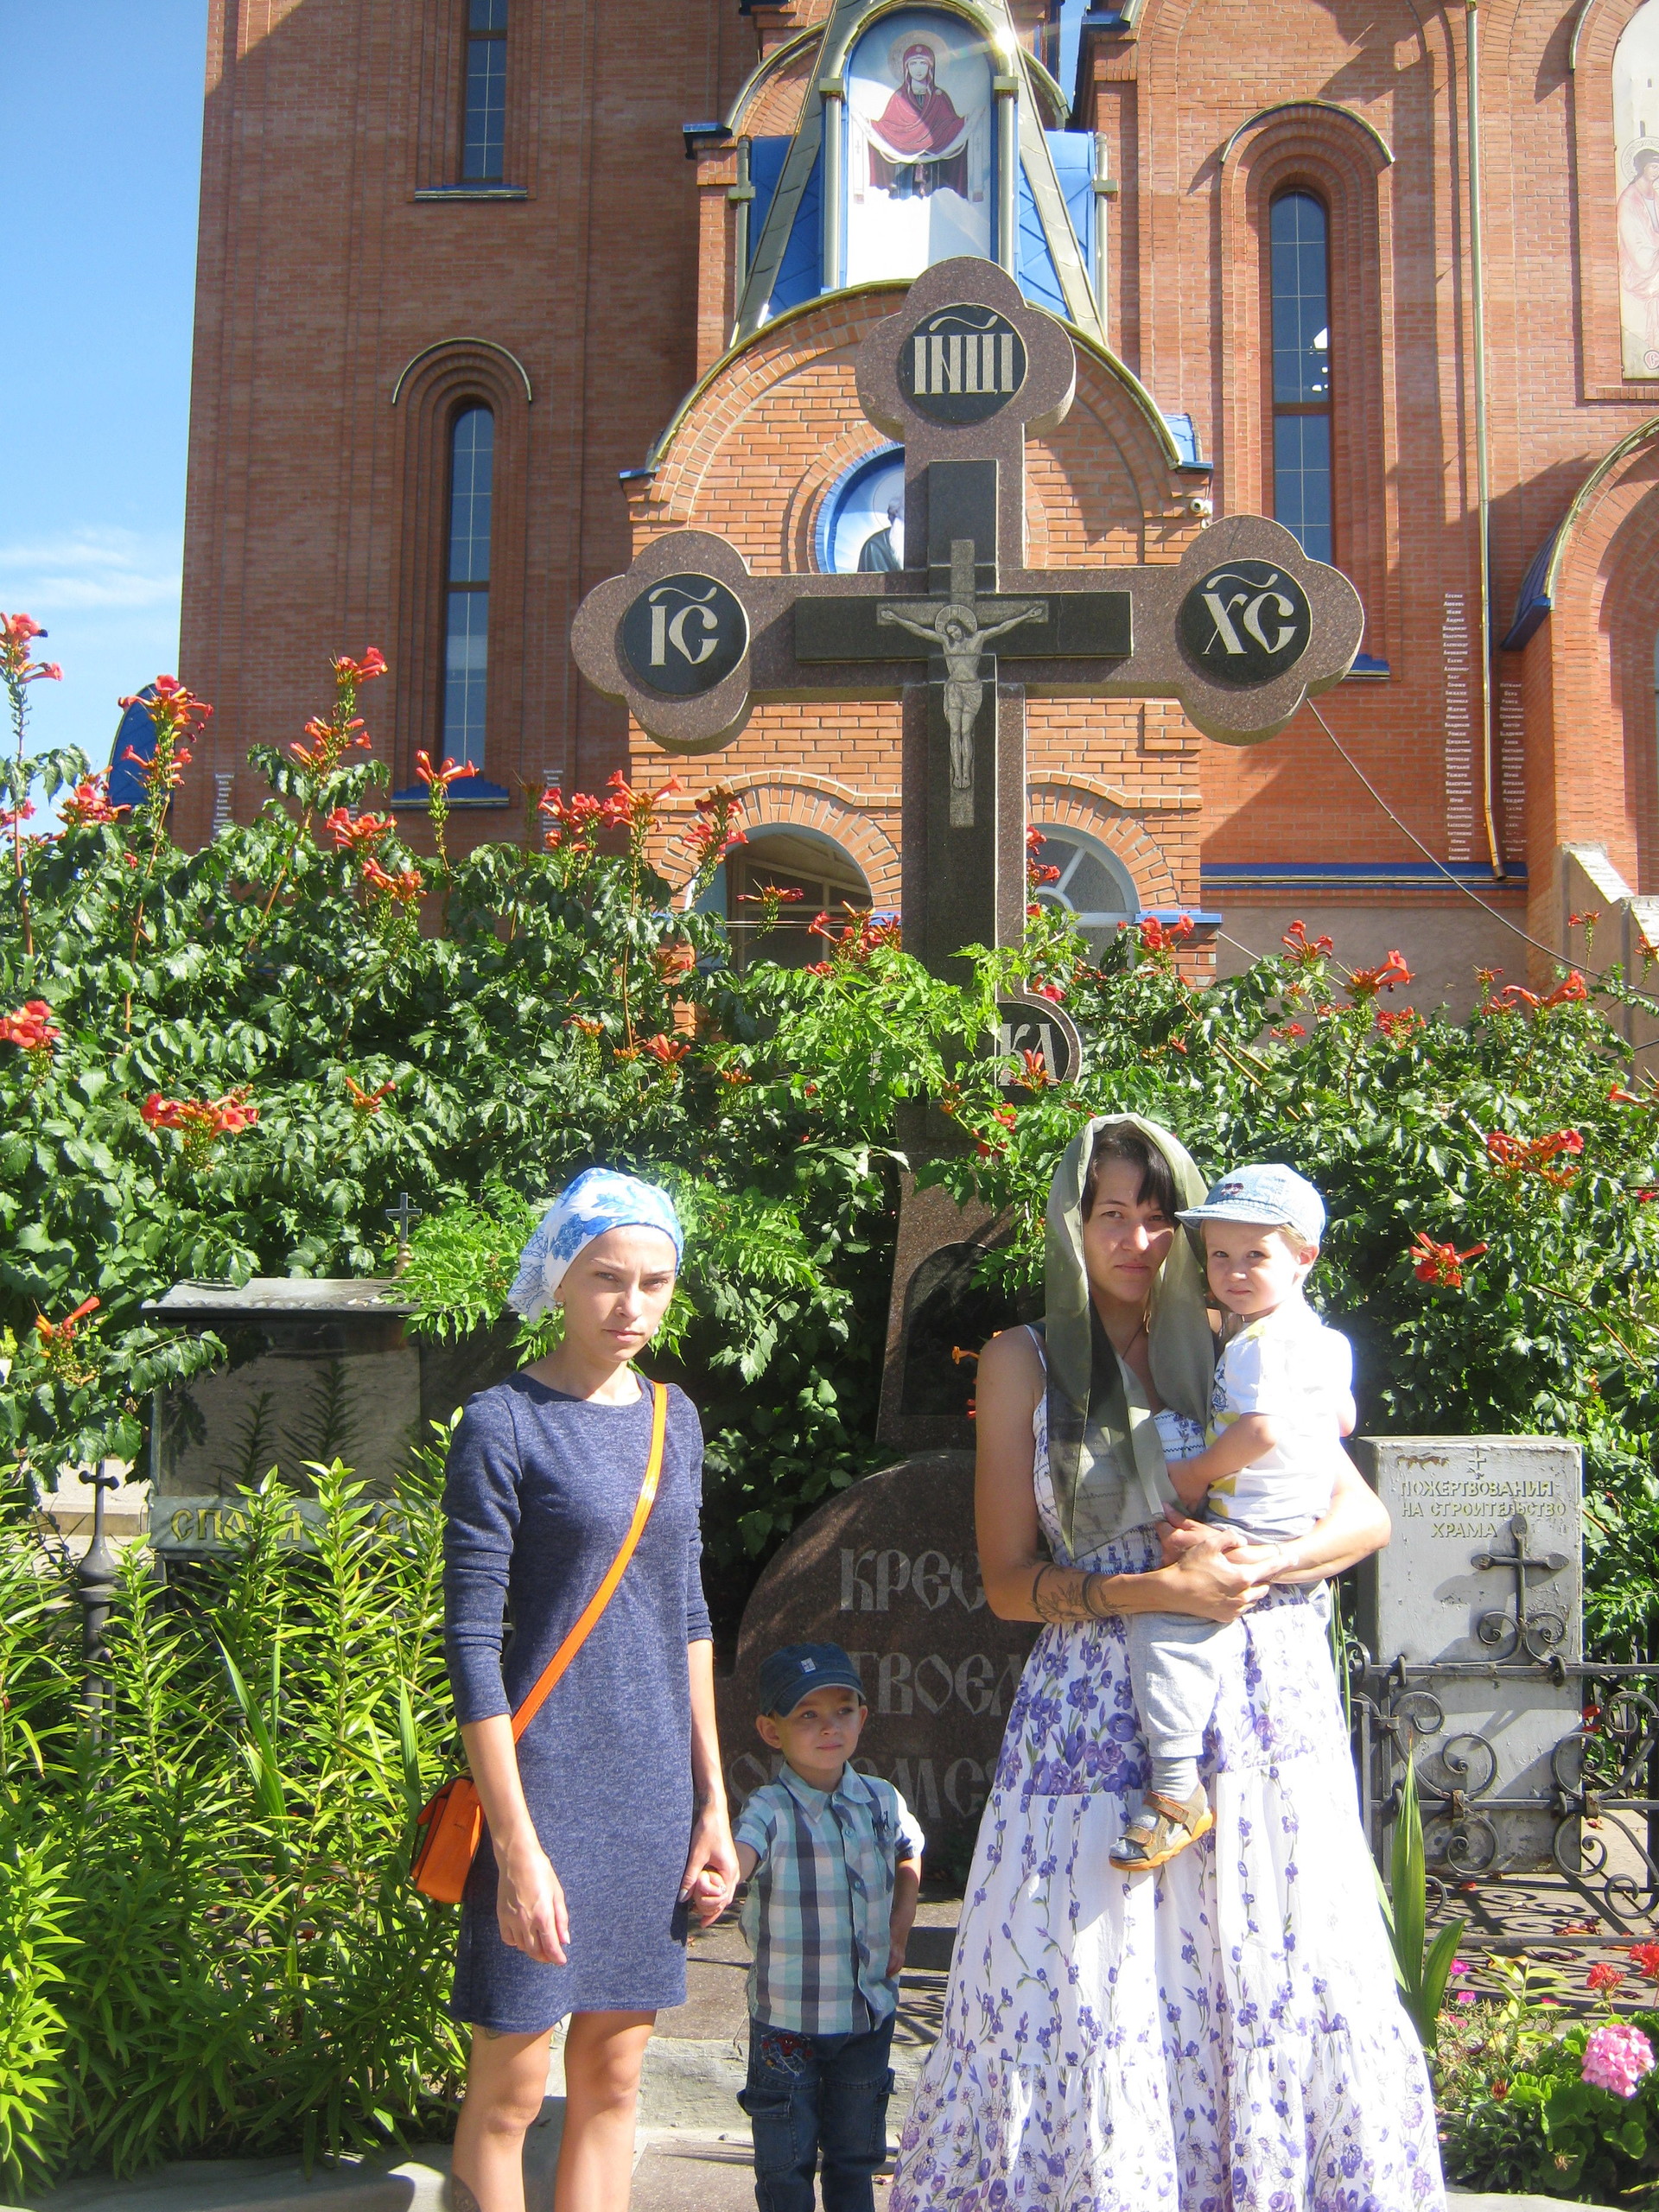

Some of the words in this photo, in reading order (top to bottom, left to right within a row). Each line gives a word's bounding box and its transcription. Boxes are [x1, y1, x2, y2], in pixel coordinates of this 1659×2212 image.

[1400, 1480, 1554, 1497] ПОЖЕРТВОВАНИЯ
[1402, 1503, 1424, 1517] НА
[1430, 1502, 1567, 1517] СТРОИТЕЛЬСТВО
[171, 1508, 302, 1541] СПАИ
[1431, 1522, 1498, 1538] ХРАМА
[840, 1548, 988, 1611] КРЕС
